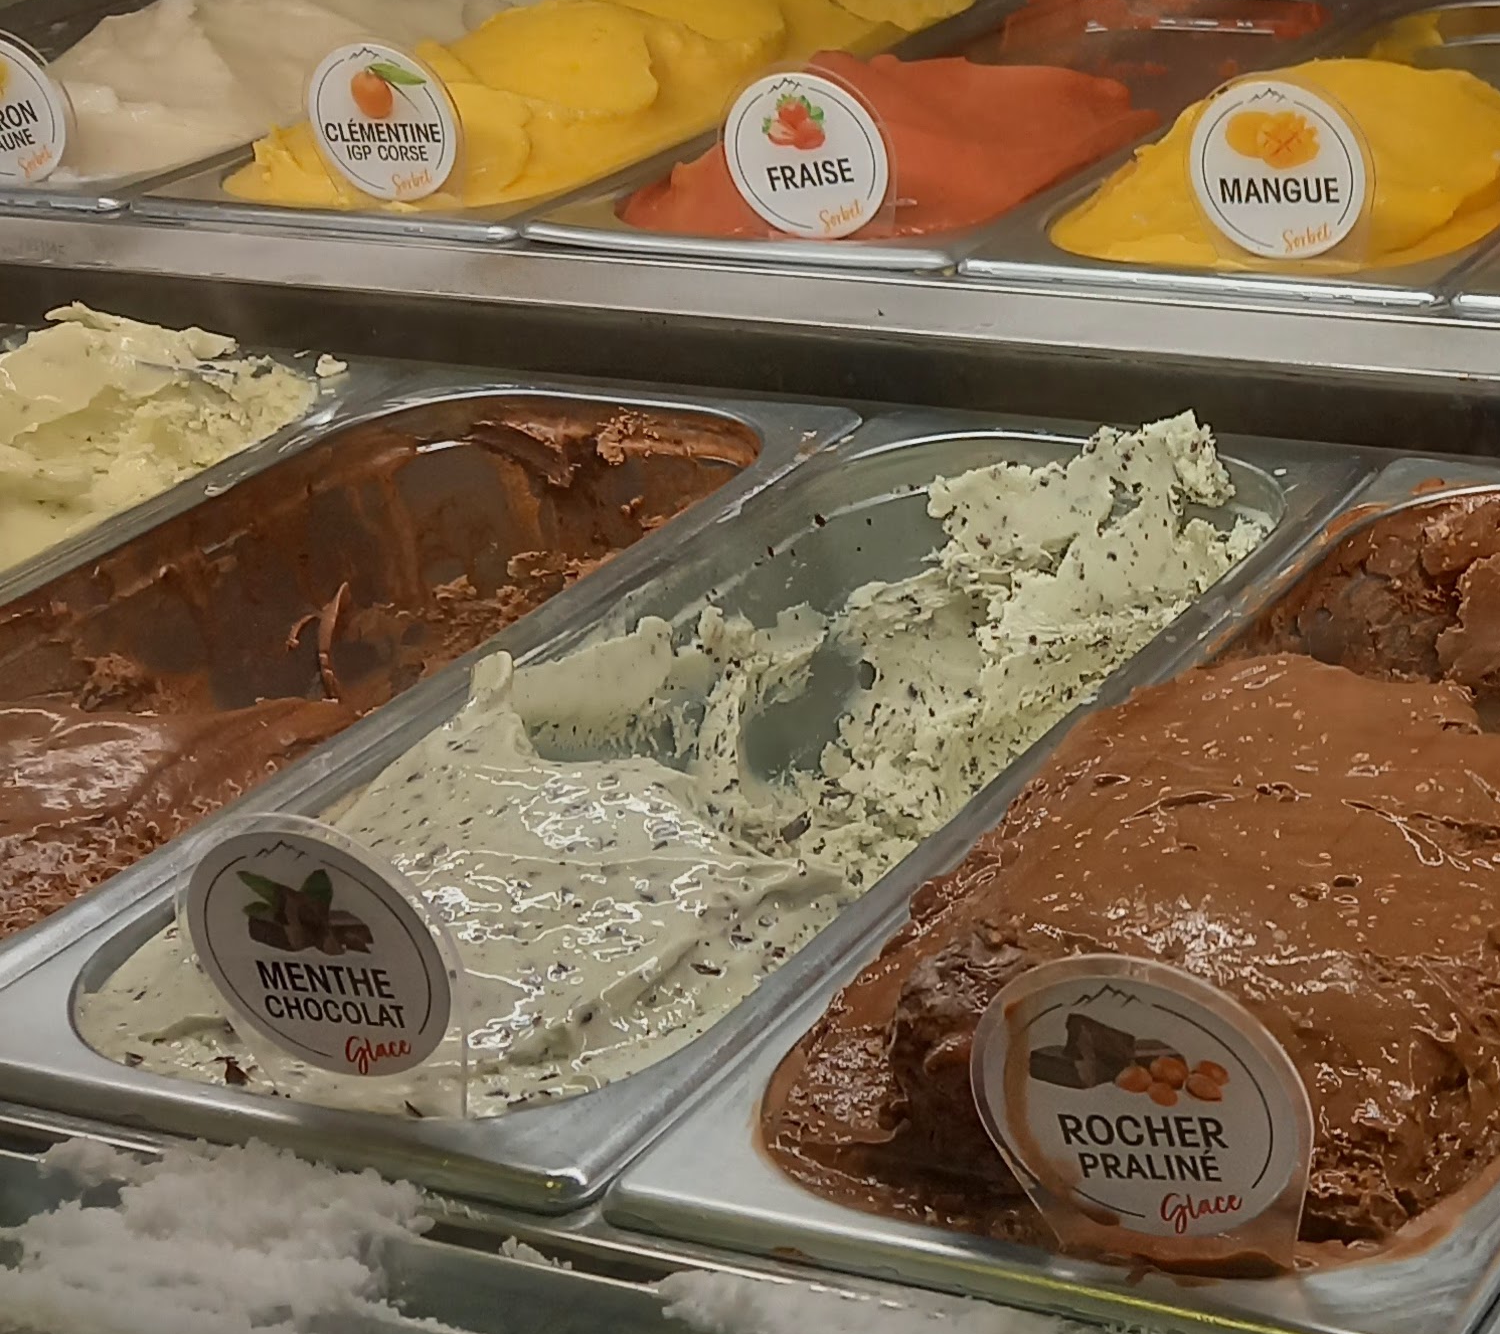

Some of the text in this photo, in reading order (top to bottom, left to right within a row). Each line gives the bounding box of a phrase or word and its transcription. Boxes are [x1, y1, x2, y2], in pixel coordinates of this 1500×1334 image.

[325, 118, 441, 143] CLÉMENTINE
[346, 145, 429, 162] IGP CORSE
[766, 158, 854, 192] FRAISE
[1219, 177, 1340, 204] MANGUE
[819, 199, 863, 232] Sorbet
[1282, 222, 1332, 253] Sorbet
[256, 960, 395, 999] MENTHE
[264, 995, 405, 1028] CHOCOLAT
[345, 1035, 412, 1076] Glace
[1057, 1114, 1229, 1149] ROCHER
[1078, 1149, 1223, 1182] PRALINÉ
[1160, 1192, 1243, 1234] Glace
